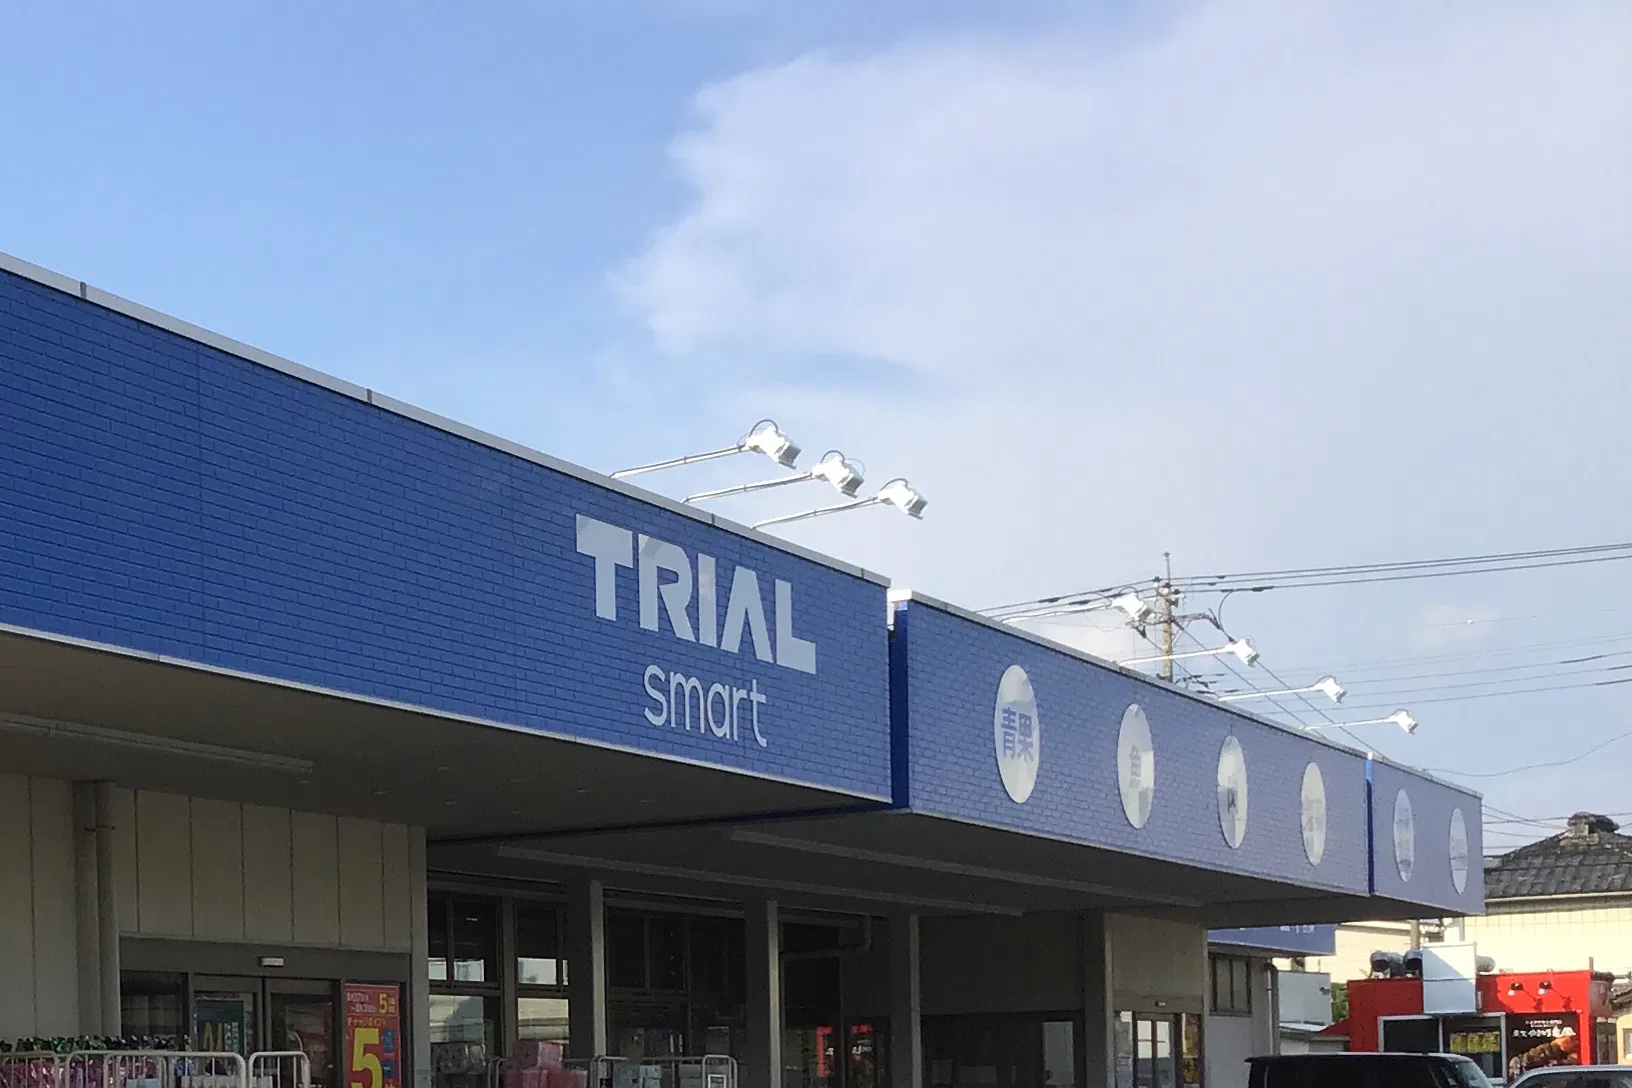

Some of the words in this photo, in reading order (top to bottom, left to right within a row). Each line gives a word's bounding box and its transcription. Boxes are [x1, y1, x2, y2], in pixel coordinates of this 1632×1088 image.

[576, 514, 816, 674] TRIAL
[643, 664, 767, 748] smart
[1000, 706, 1034, 763] 青果
